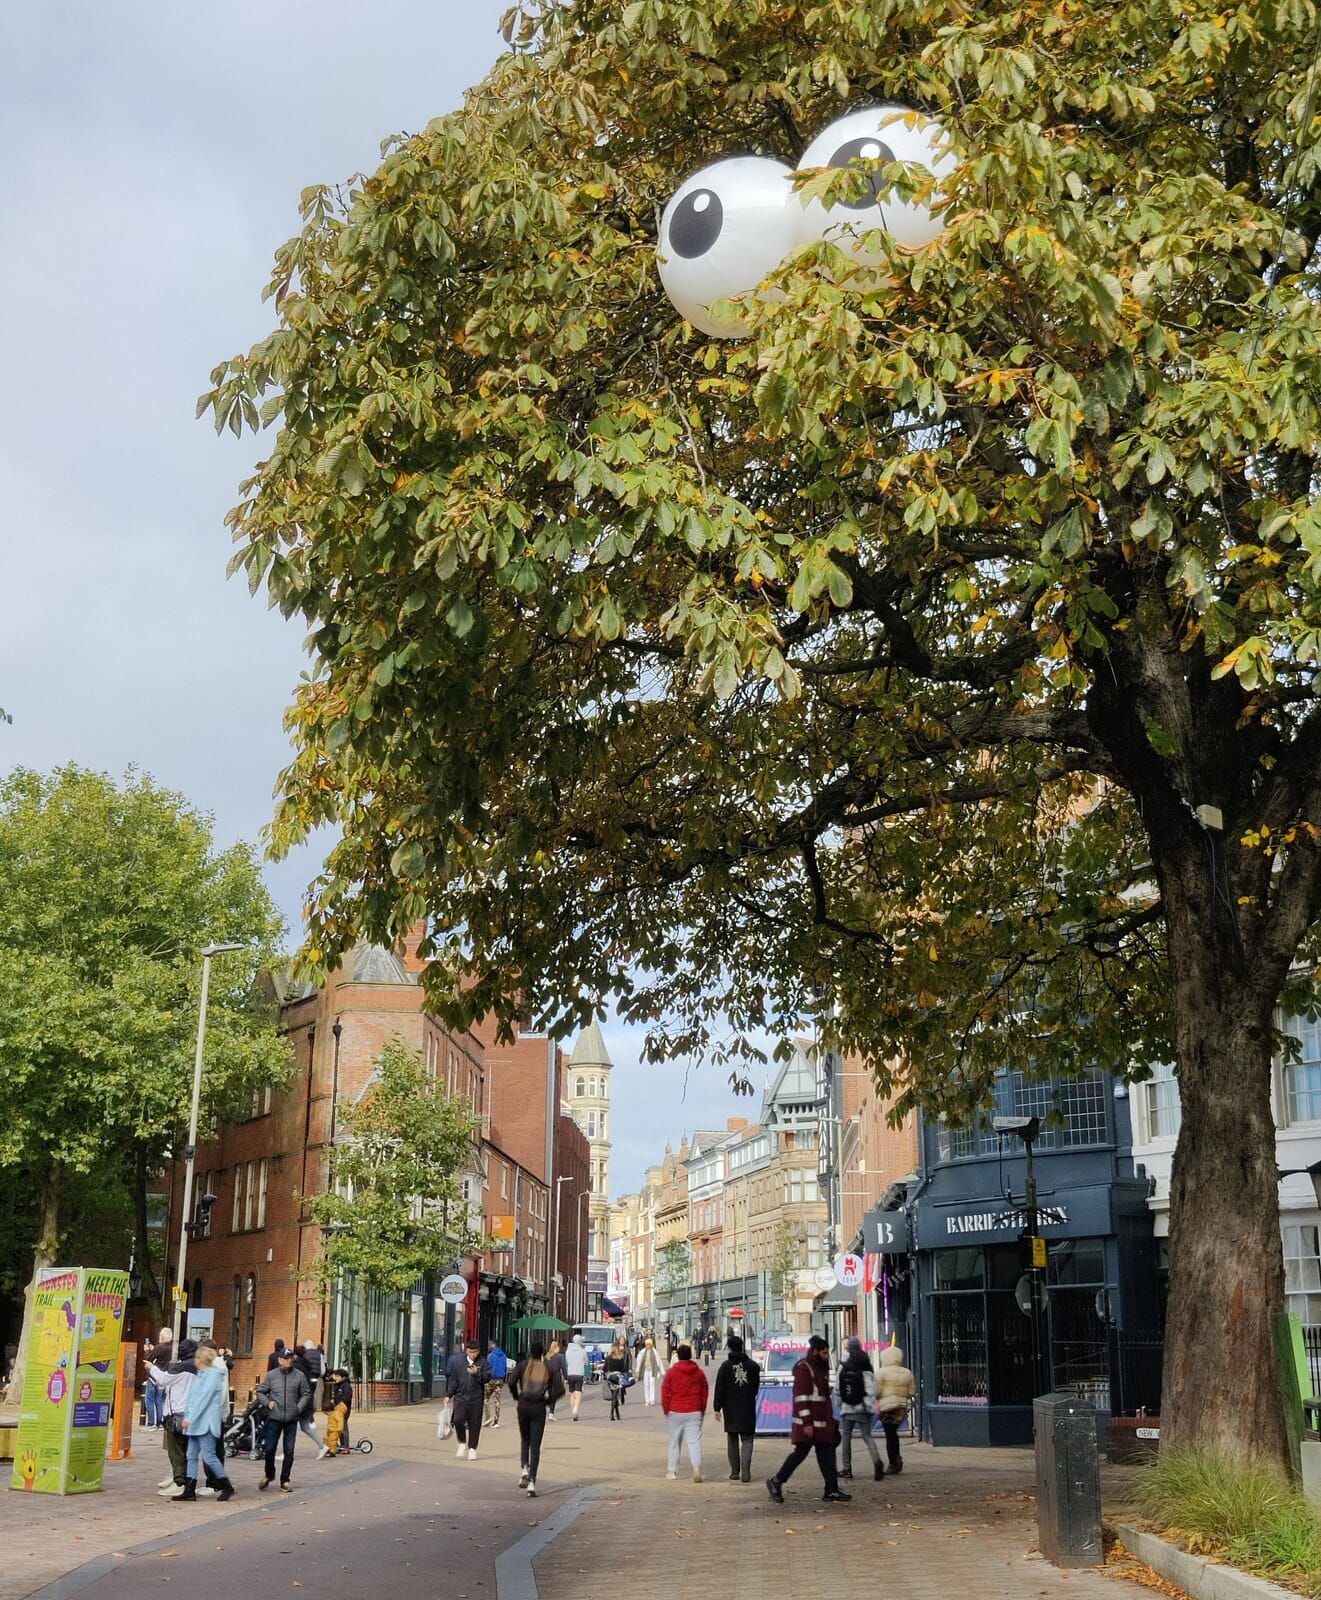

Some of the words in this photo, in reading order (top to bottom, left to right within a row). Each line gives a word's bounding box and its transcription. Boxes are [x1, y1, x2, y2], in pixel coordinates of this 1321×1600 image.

[946, 1213, 998, 1234] BARRIE
[877, 1222, 894, 1244] B
[85, 1276, 111, 1293] MEET
[110, 1277, 128, 1295] THE
[35, 1294, 54, 1306] TRAIL
[84, 1293, 124, 1309] MONSTERS
[1138, 1430, 1153, 1438] NEW
